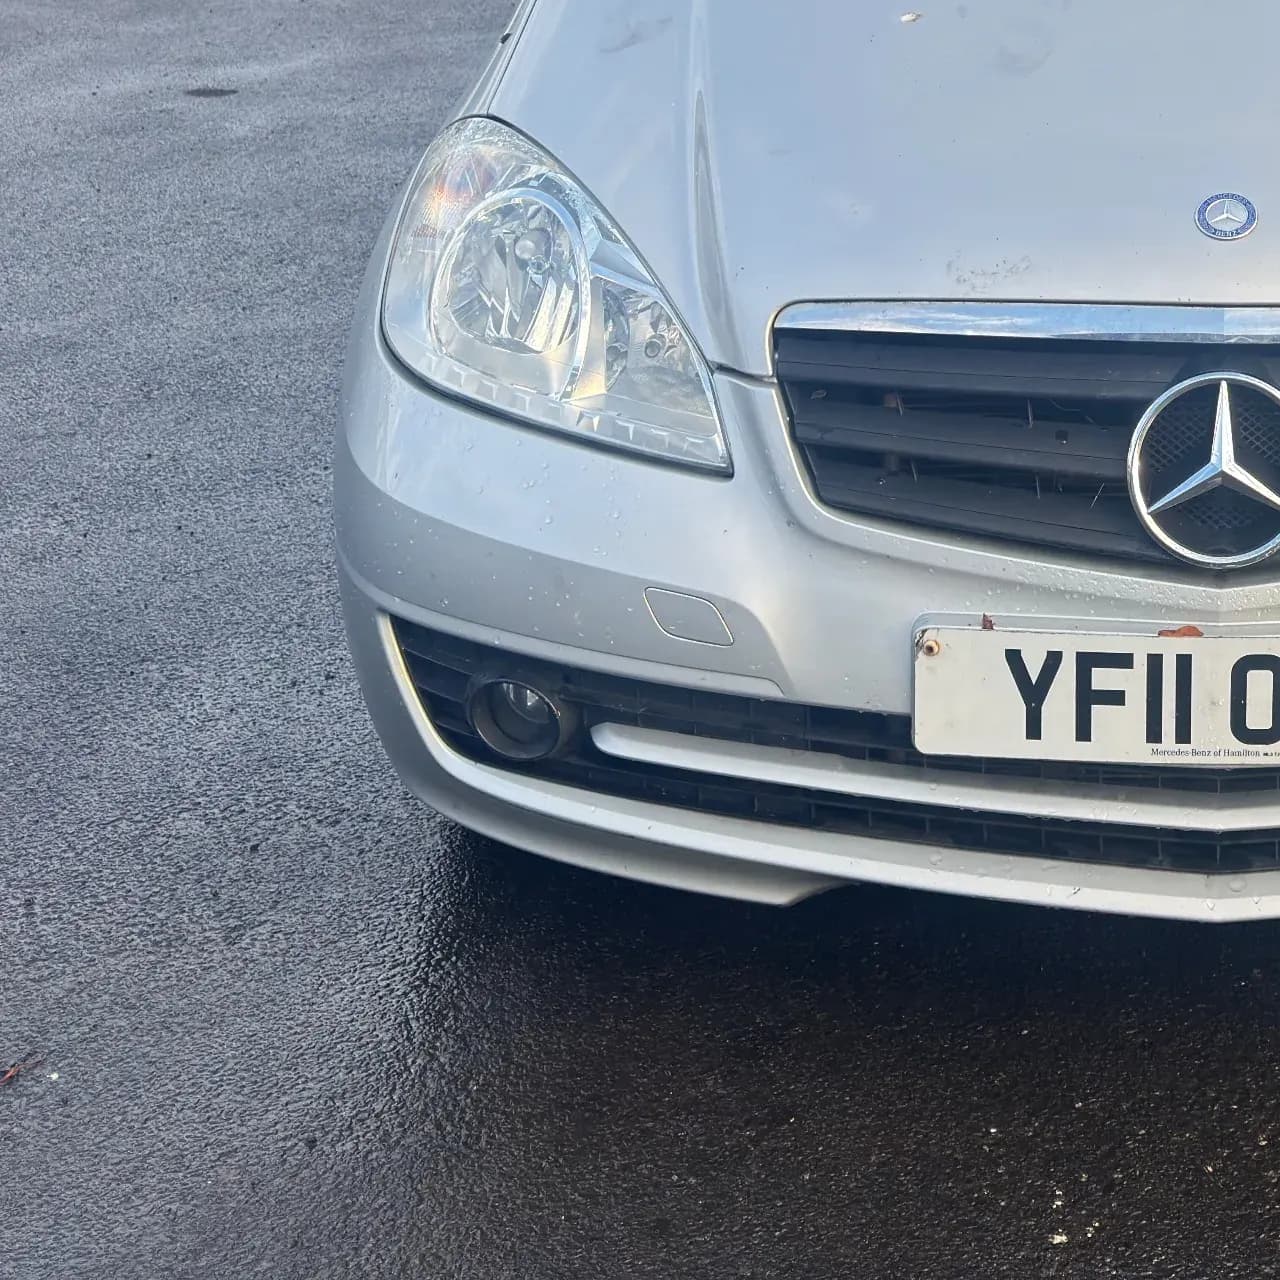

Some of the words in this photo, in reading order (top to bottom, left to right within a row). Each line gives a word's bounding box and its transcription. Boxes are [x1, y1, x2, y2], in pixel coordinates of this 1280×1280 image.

[1005, 649, 1192, 745] YF11
[1150, 748, 1211, 757] Mercedes-Benz
[1213, 748, 1222, 757] of
[1223, 748, 1260, 757] Hamilton
